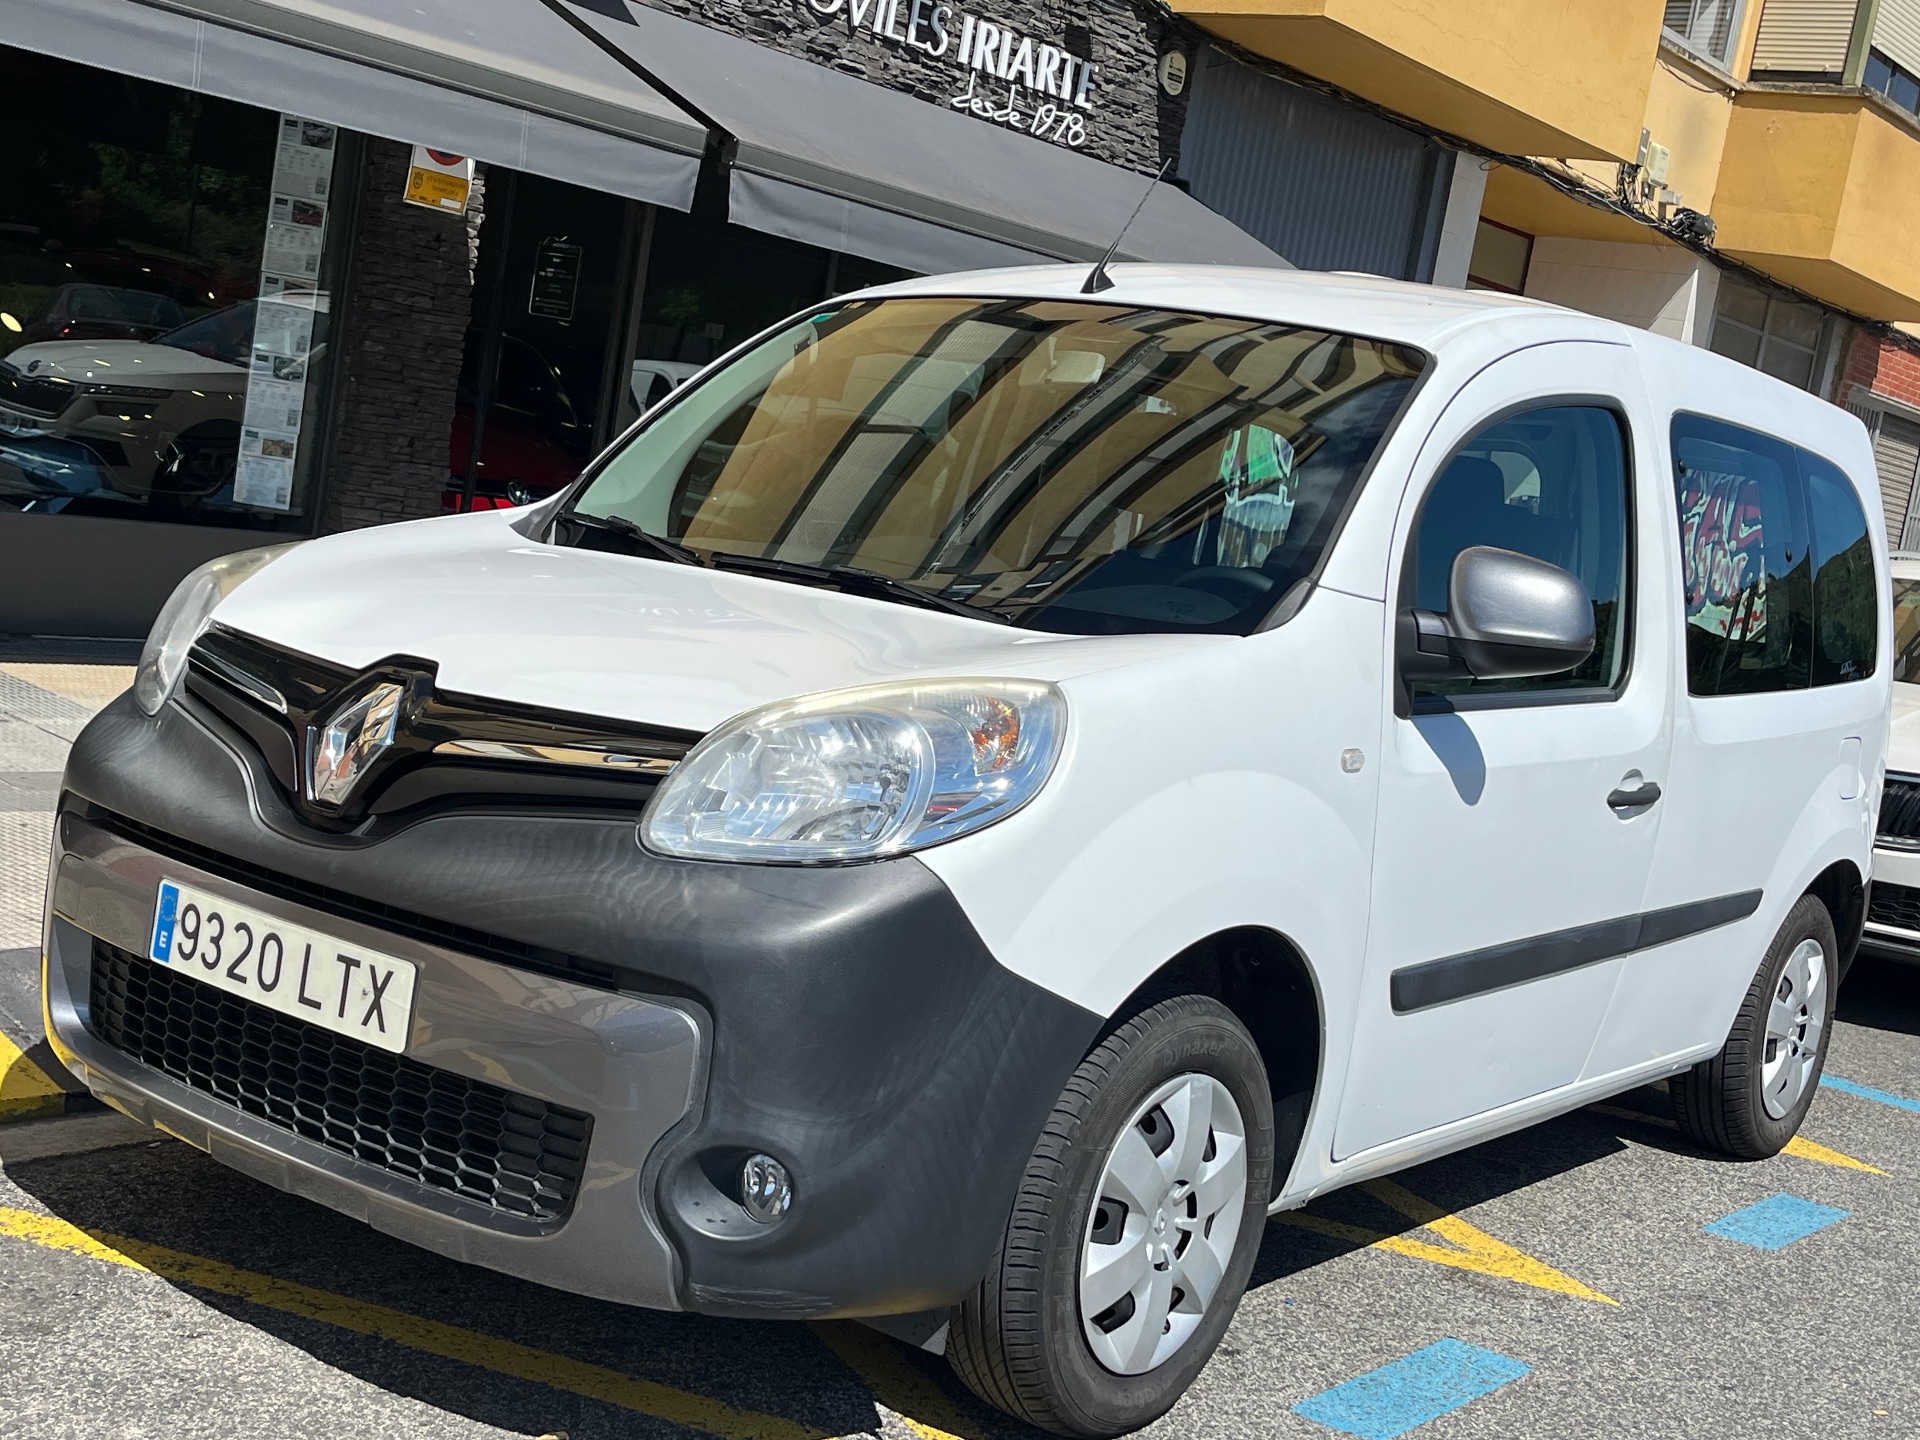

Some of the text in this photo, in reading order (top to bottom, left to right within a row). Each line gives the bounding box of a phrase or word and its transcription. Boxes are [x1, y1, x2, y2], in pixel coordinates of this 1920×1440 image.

[807, 0, 1099, 110] VILES IRIARTE
[950, 70, 1086, 146] desde 1978
[158, 930, 168, 948] E
[177, 903, 394, 1034] 9320 LTX
